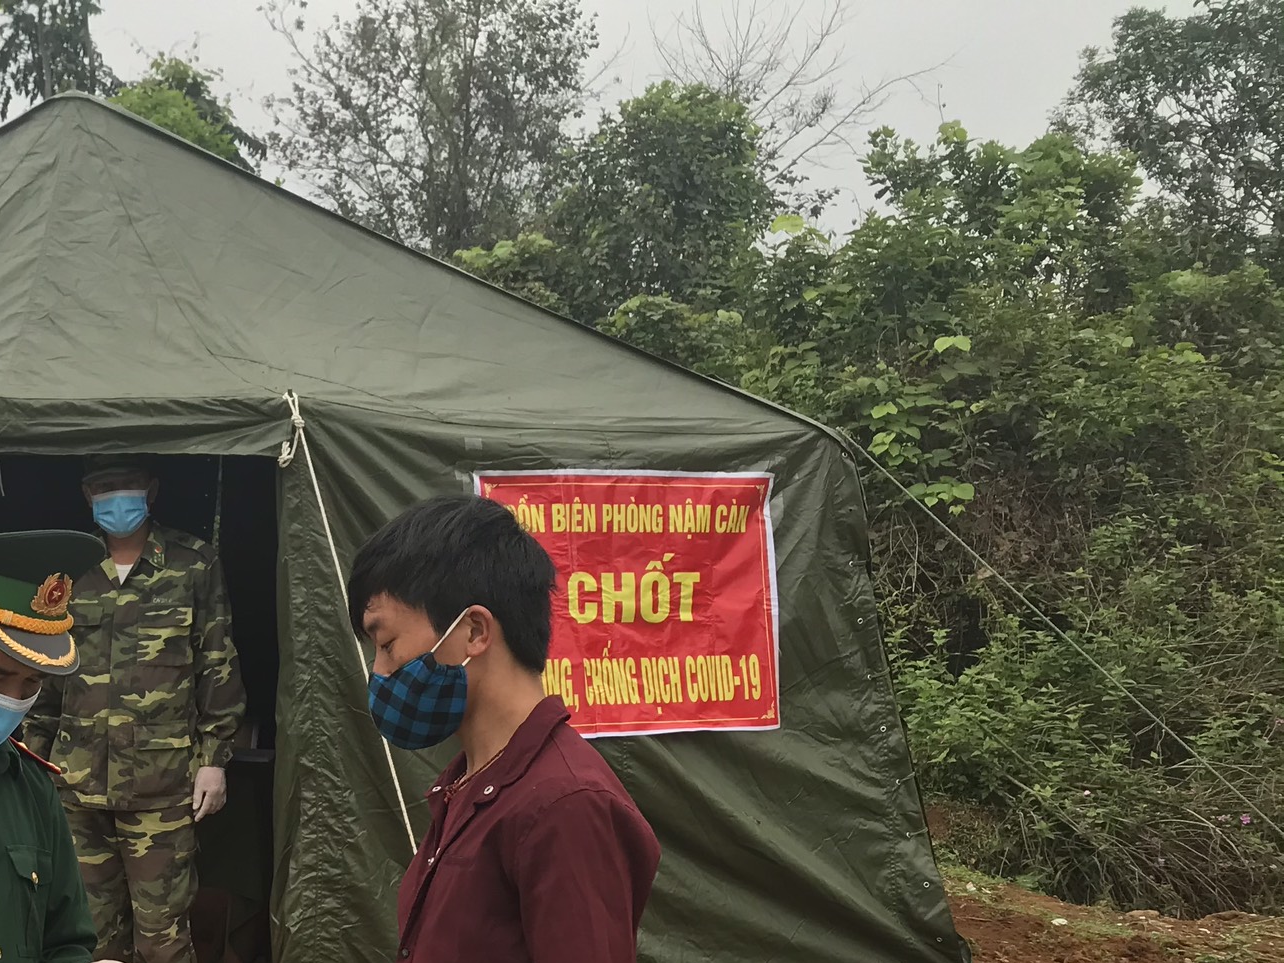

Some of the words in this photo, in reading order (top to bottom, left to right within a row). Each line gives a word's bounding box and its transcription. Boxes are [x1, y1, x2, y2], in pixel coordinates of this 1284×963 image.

[552, 496, 597, 533] BIÊN
[602, 497, 664, 534] PHÒNG
[668, 498, 712, 540] NẬM
[715, 499, 750, 534] CÀN
[567, 552, 701, 625] CHỐT
[583, 640, 641, 706] CHỐNG
[641, 656, 683, 715] DỊCH
[685, 653, 762, 703] COVID-19
